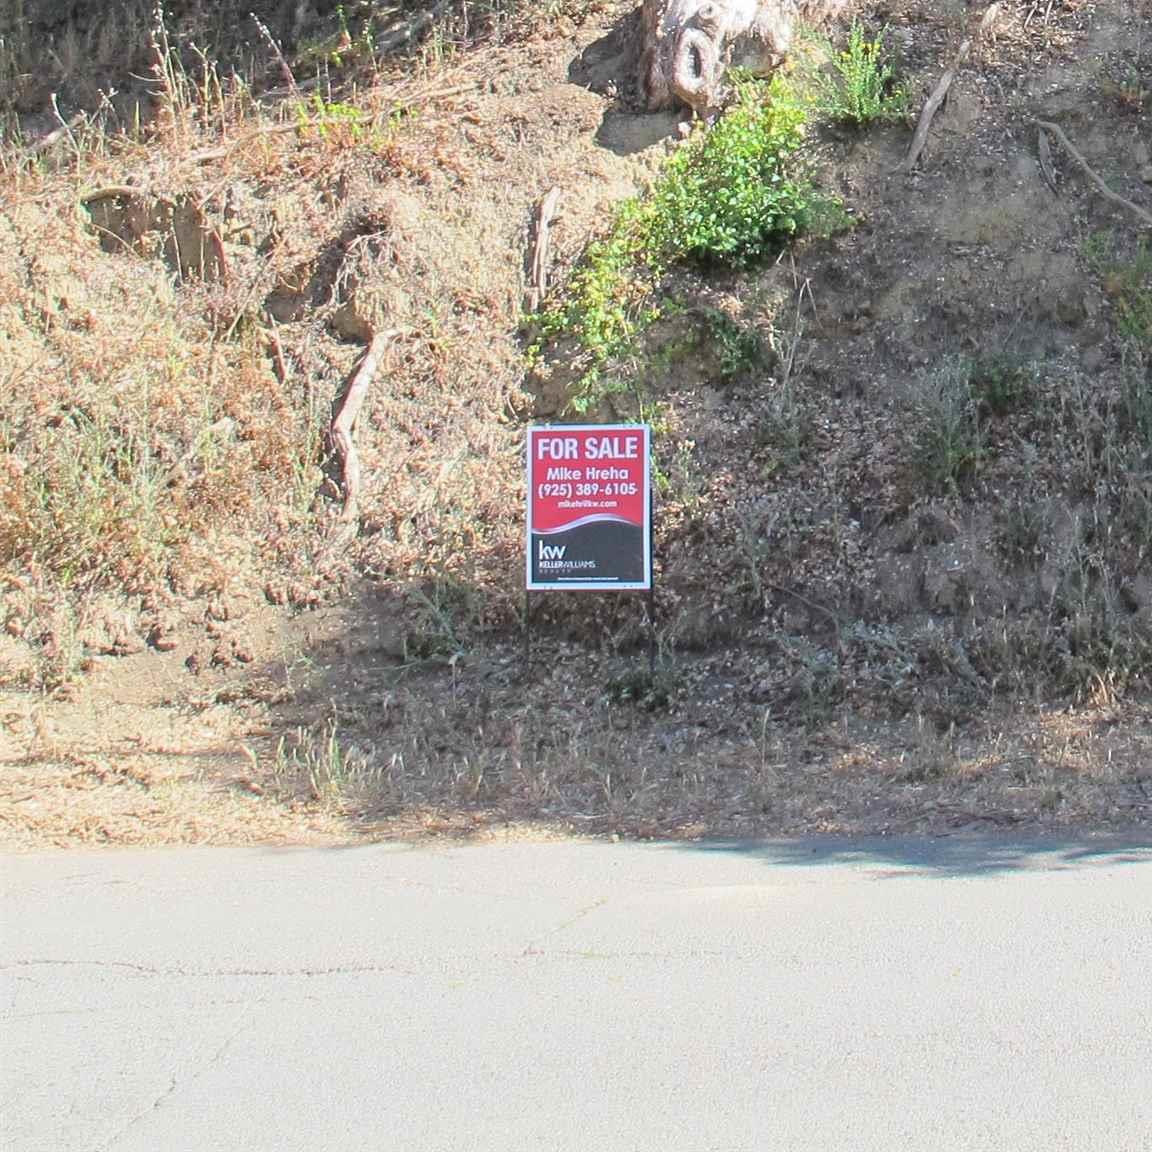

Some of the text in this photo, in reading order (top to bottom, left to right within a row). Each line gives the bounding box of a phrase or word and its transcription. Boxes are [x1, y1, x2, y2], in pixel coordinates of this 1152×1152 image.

[537, 436, 639, 460] FOR SALE
[546, 467, 629, 481] Mike Hreha
[538, 483, 637, 499] (925) 389-6105
[538, 539, 566, 560] kw
